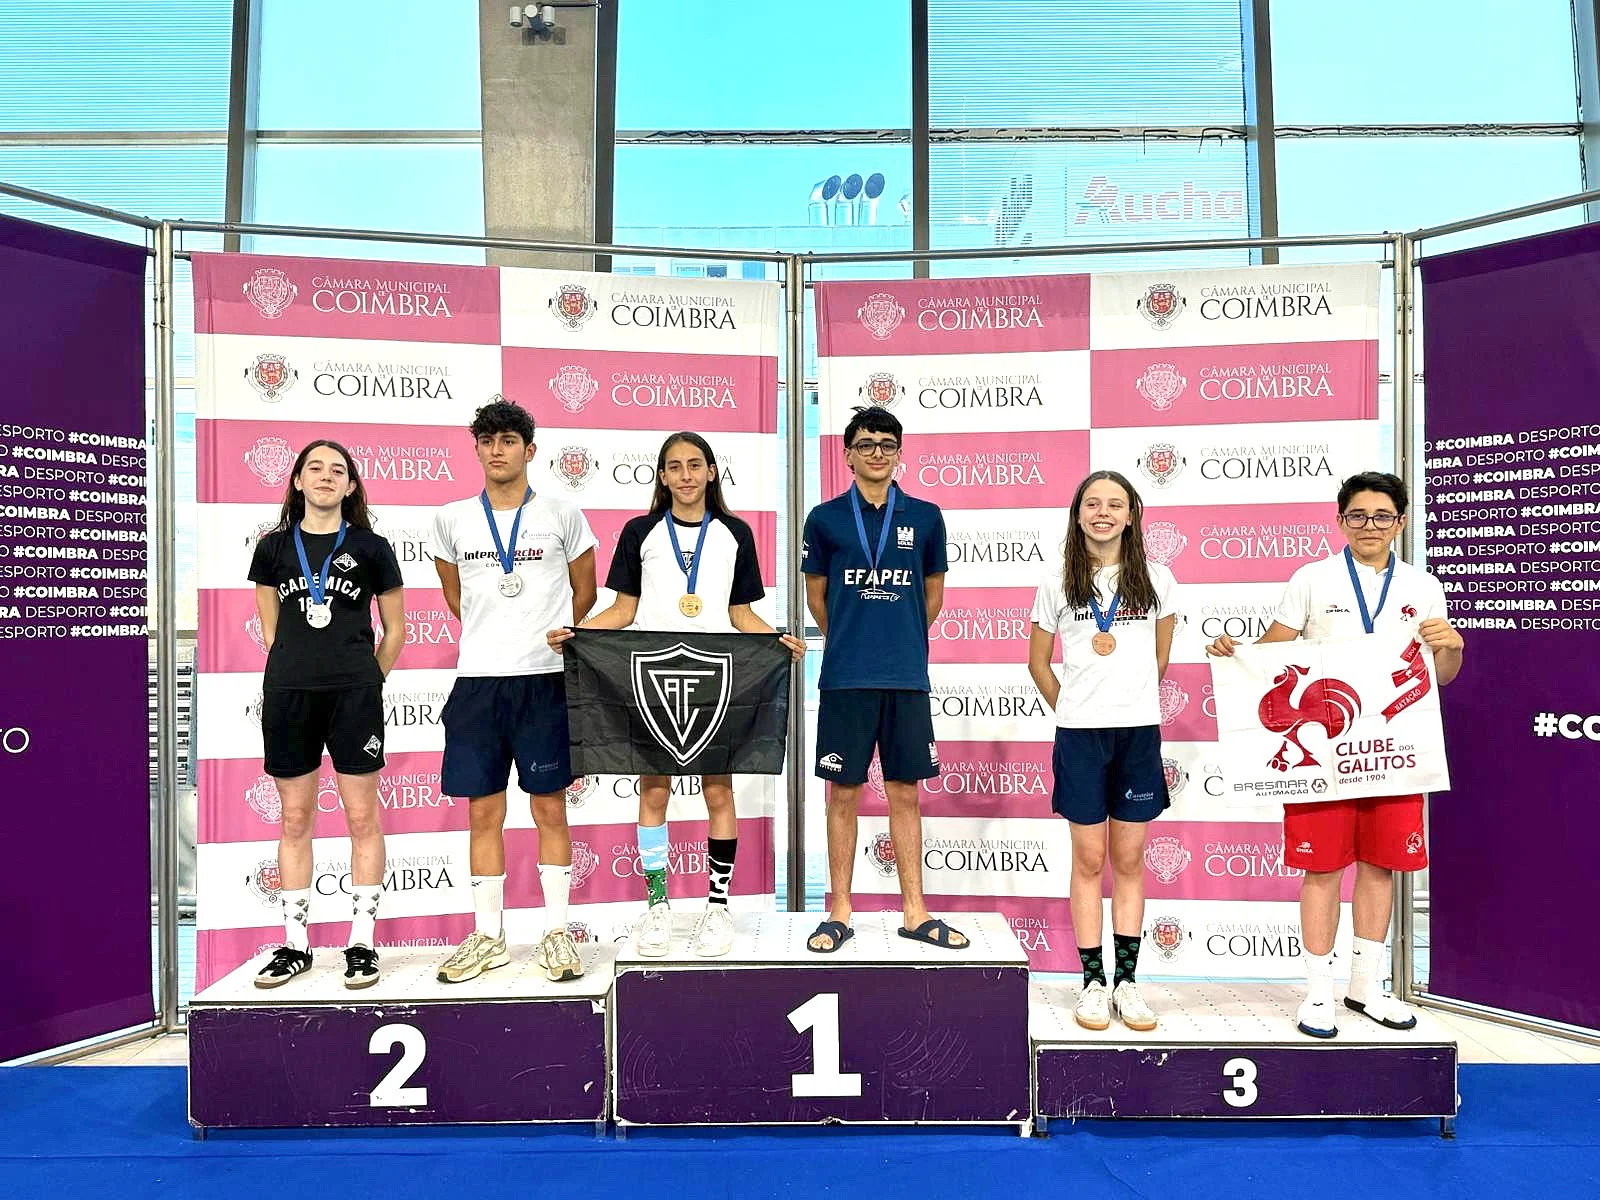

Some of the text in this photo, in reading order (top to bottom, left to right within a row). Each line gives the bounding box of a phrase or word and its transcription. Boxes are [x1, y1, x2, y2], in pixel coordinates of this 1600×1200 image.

[1075, 176, 1243, 224] Aucha
[376, 279, 450, 294] MUNICIPAL
[1261, 282, 1332, 297] MUNICIPAL
[312, 290, 453, 318] COIMBRA
[669, 294, 735, 308] MUNICIPAL
[975, 295, 1042, 309] MUNICIPAL
[1200, 295, 1333, 321] COIMBRA
[611, 304, 736, 330] COIMBRA
[918, 308, 1044, 331] COIMBRA
[1200, 363, 1332, 378] CÂMARA MUNICIPAL
[313, 374, 453, 399] COIMBRA
[669, 374, 736, 388] MUNICIPAL
[1200, 376, 1334, 401] COIMBRA
[611, 384, 737, 409] COIMBRA
[918, 386, 1043, 409] COIMBRA
[0, 424, 146, 450] SPORTO #COIMBRA
[1435, 434, 1514, 451] #COIMBRA
[1519, 424, 1600, 443] DESPORTO
[12, 446, 98, 465] #COIMBRA
[101, 454, 146, 469] DESPO
[350, 445, 452, 460] ARA MUNICIPAL
[613, 451, 656, 464] CÂMAR
[976, 451, 1043, 465] MUNICIPAL
[1425, 445, 1600, 470] MBRA DESPORTO #COIM
[24, 467, 105, 484] DESPORTO
[351, 457, 455, 481] OIMBRA
[918, 463, 1045, 487] COIMBRA
[1200, 456, 1334, 480] COIMBRA
[1425, 464, 1600, 487] PORTO #COIMBRA DESP
[0, 485, 147, 506] SPORTO #COIMBRA
[1435, 488, 1515, 504] #COIMBRA
[1519, 482, 1600, 500] DESPORTO
[1441, 506, 1518, 522] DESPORTO
[0, 525, 147, 542] SPORTO #COIMBRA
[946, 530, 972, 541] ARA
[1200, 523, 1333, 538] CÂMARA MUNICIPAL
[1436, 525, 1516, 540] #COIMBRA
[1520, 520, 1600, 536] DESPORTO
[13, 546, 99, 560] #COIMBRA
[103, 549, 147, 561] DESPO
[946, 541, 1045, 563] OIMBRA
[1200, 536, 1333, 560] COIMBRA
[1426, 541, 1600, 558] MBRA DESPORTO #COIM
[0, 566, 147, 580] SPORTO #COIMBRA
[1437, 562, 1516, 575] #COIMBRA
[1520, 560, 1600, 574] DESPORTO
[844, 568, 912, 586] EFAPEL
[1468, 580, 1547, 593] DESPORTO
[1550, 579, 1600, 592] #COIM
[13, 586, 99, 599] #COIMBRA
[103, 587, 147, 599] DESPO
[25, 606, 107, 618] DESPORTO
[939, 607, 972, 619] MARA
[1474, 599, 1557, 611] #COIMBRA
[1561, 599, 1600, 612] DESP
[404, 610, 453, 622] NICIPAL
[1449, 617, 1600, 631] COIMBRA DESPORTO
[0, 625, 148, 639] SPORTO #COIMBRA
[928, 619, 1031, 641] COIMBR
[977, 684, 1040, 697] MUNICIPA
[1336, 738, 1415, 757] CLUBE DOS
[940, 761, 1047, 774] MARA MUNICIPAL
[1337, 754, 1416, 775] GALITOS
[923, 773, 1048, 796] COIMBRA
[1233, 779, 1308, 792] BRESMAR
[1338, 774, 1386, 785] desde 1904
[317, 785, 456, 814] CMBRA
[979, 838, 1048, 852] MUNICIPAL
[924, 850, 1050, 873] COIMBRA
[1007, 917, 1049, 929] ICIPAL
[1206, 934, 1302, 958] COIMB
[789, 994, 863, 1098] 1
[368, 1025, 428, 1107] 2
[1222, 1058, 1258, 1107] 3
